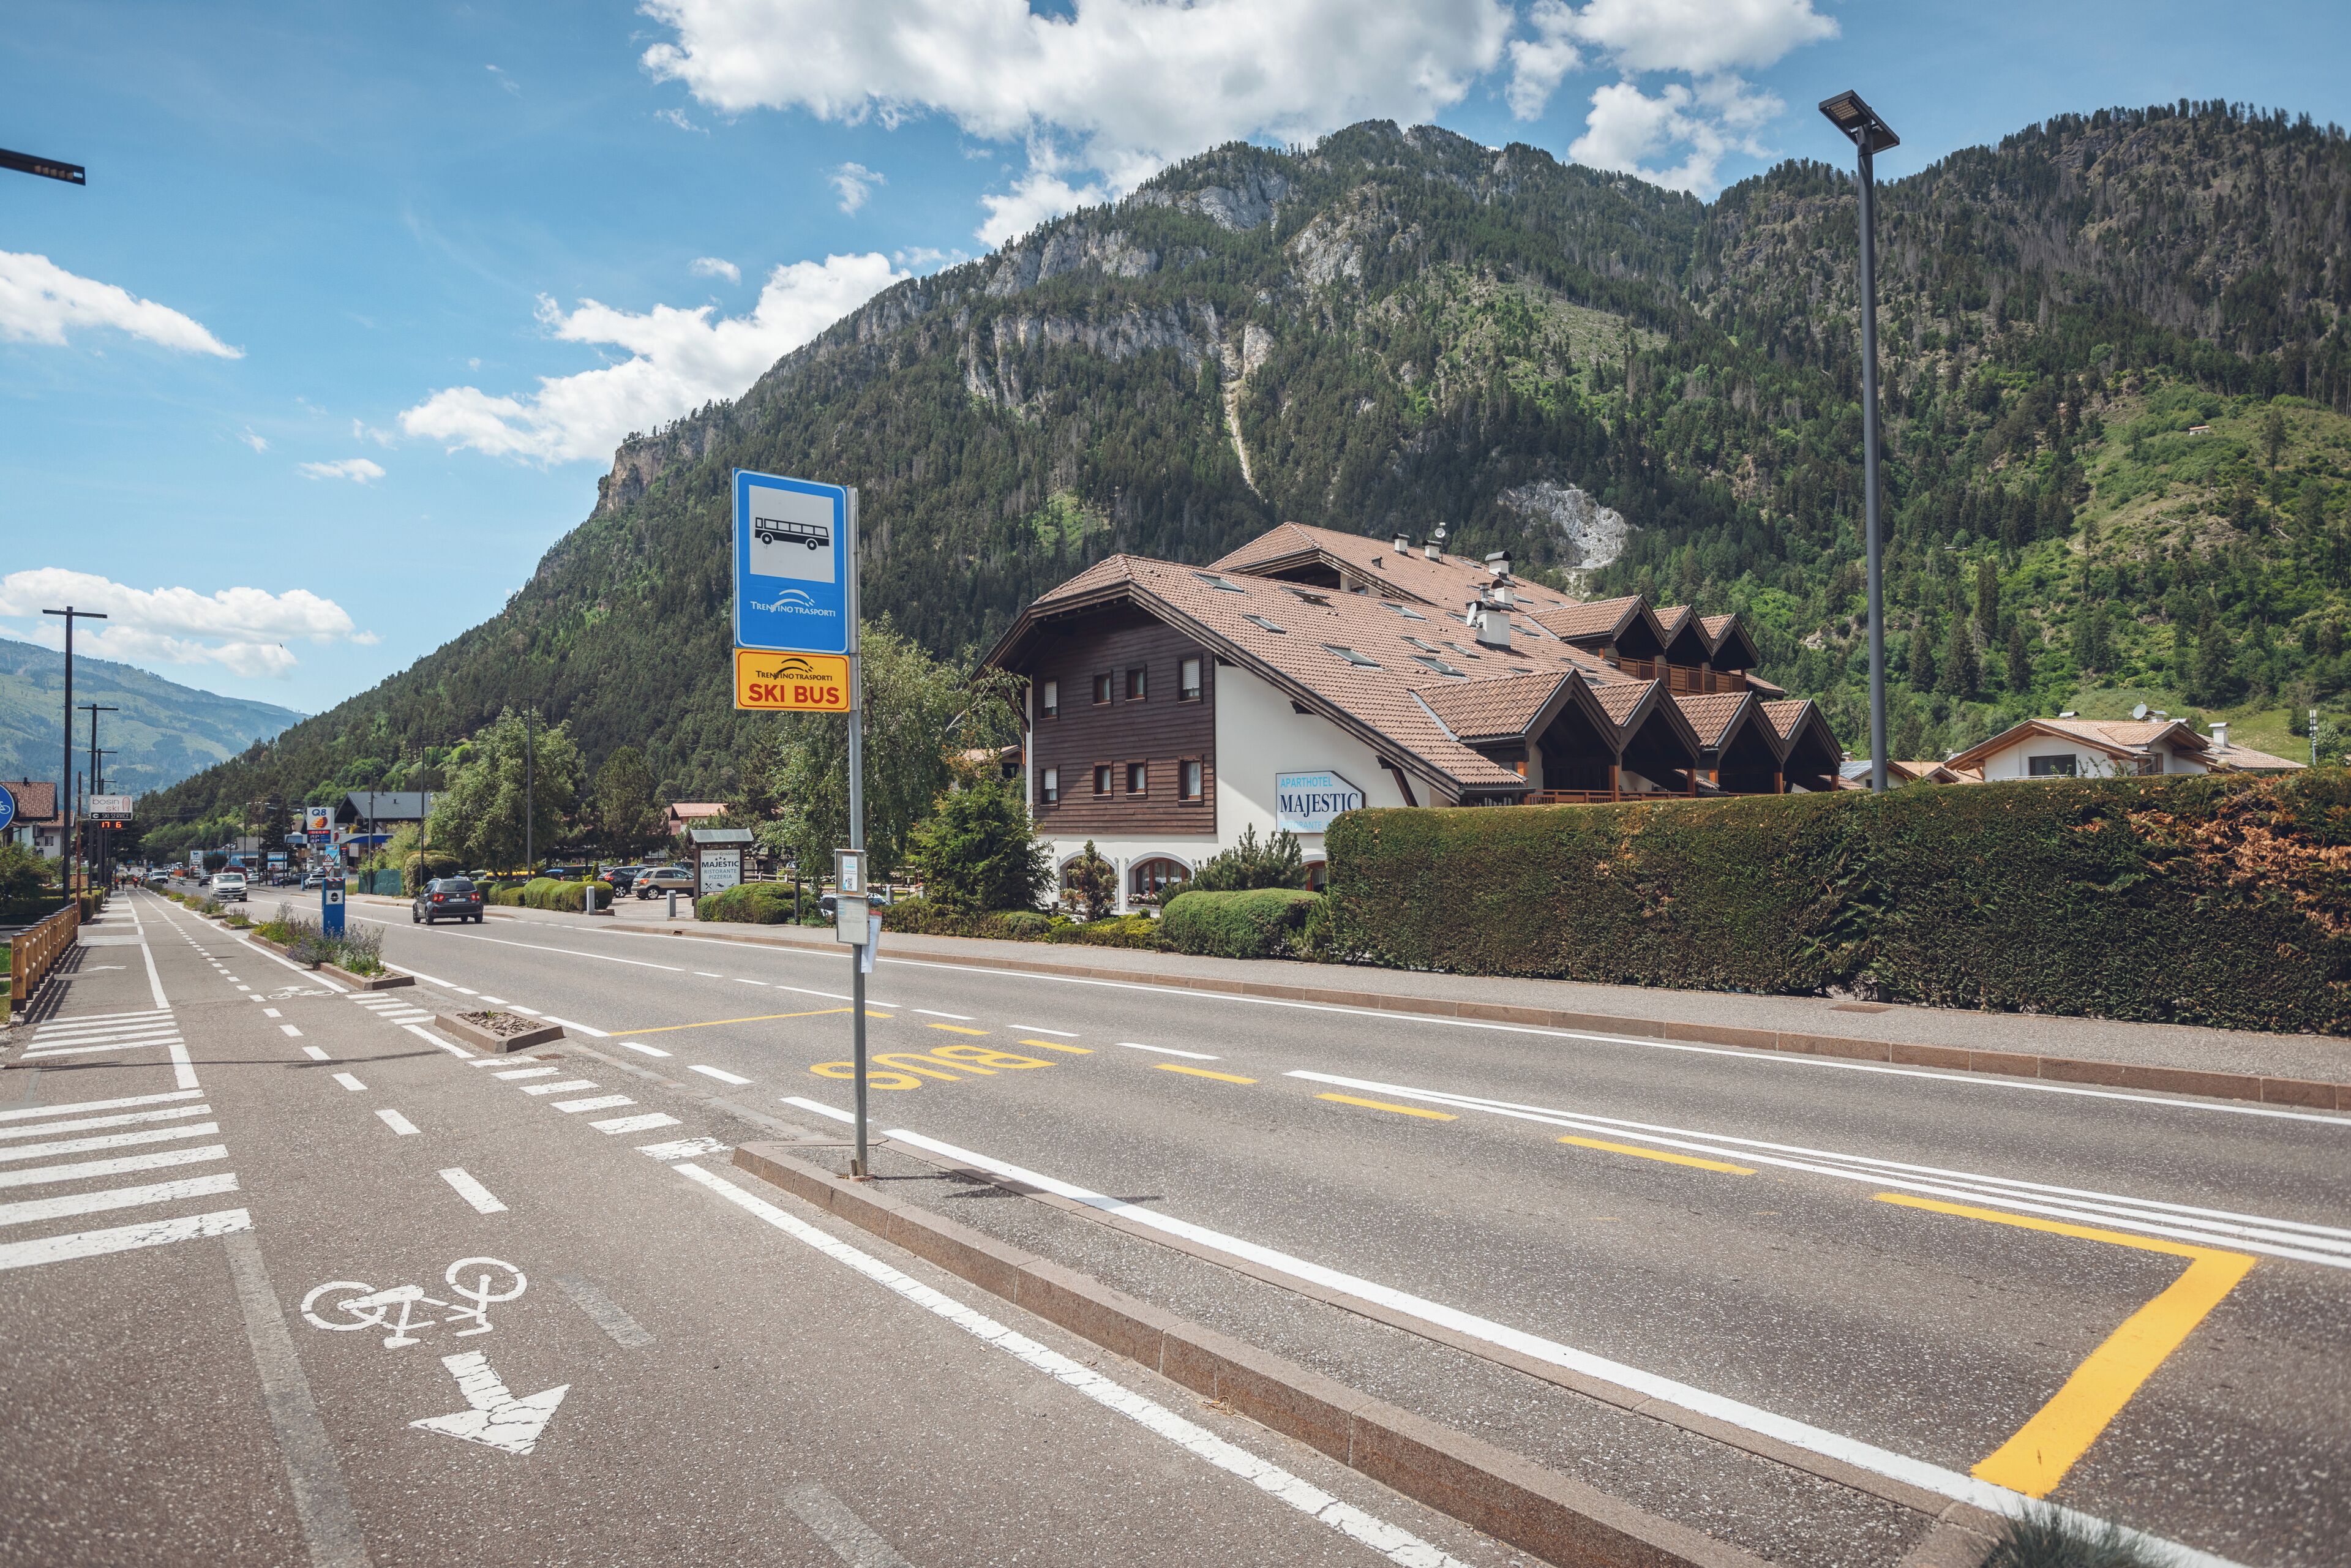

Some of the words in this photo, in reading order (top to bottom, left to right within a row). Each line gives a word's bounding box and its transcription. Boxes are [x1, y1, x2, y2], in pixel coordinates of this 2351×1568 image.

[750, 601, 793, 612] TRENTINO
[795, 607, 836, 617] TRASPORTI
[756, 670, 794, 680] TRENTINO
[748, 683, 785, 702] SKI
[795, 685, 839, 704] BUS
[1280, 776, 1333, 788] APARTHOTEL
[1280, 793, 1359, 817] MAJESTIC
[1280, 821, 1322, 830] RISTORANTE
[809, 1045, 1058, 1090] BUS
